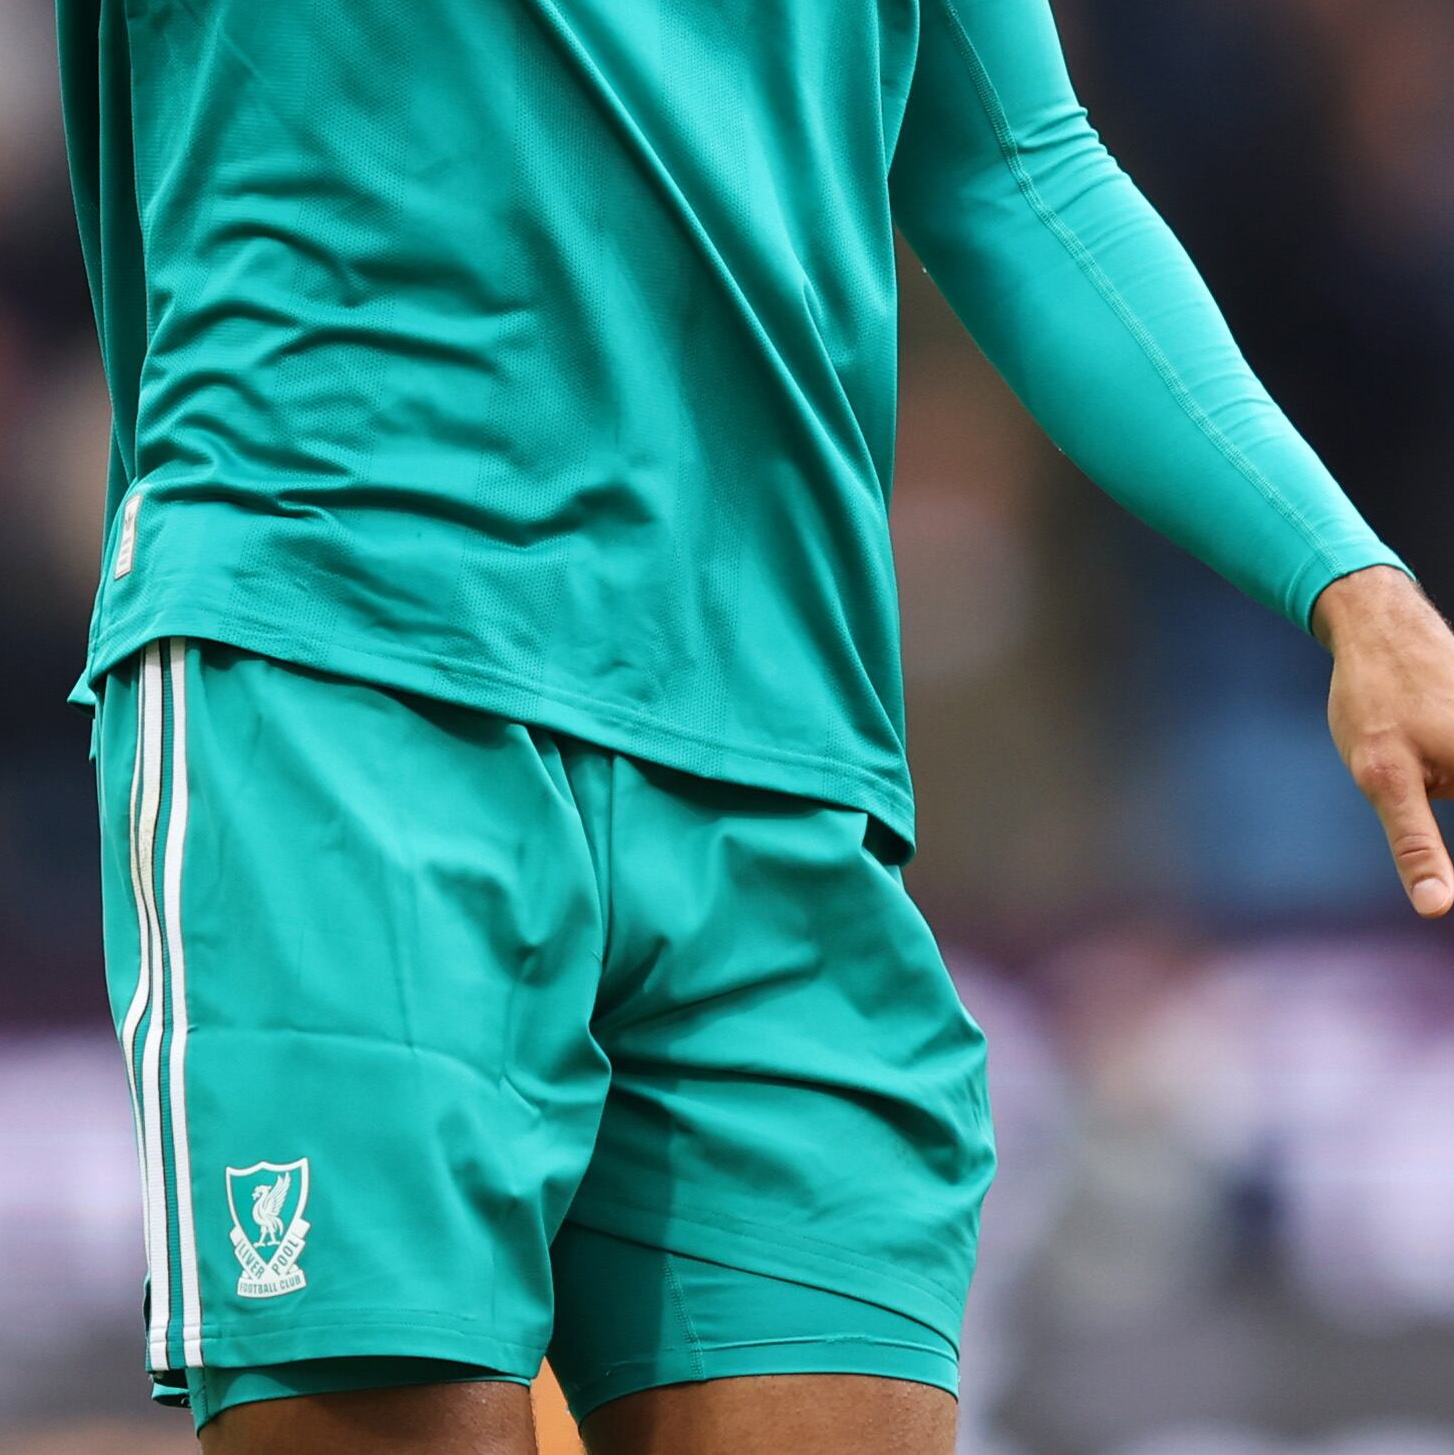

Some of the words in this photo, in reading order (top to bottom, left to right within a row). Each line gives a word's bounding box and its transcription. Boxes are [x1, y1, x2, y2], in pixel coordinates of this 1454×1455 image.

[271, 1239, 299, 1276] POOL
[239, 1281, 278, 1295] FOOTBALL
[279, 1274, 302, 1290] CLUB
